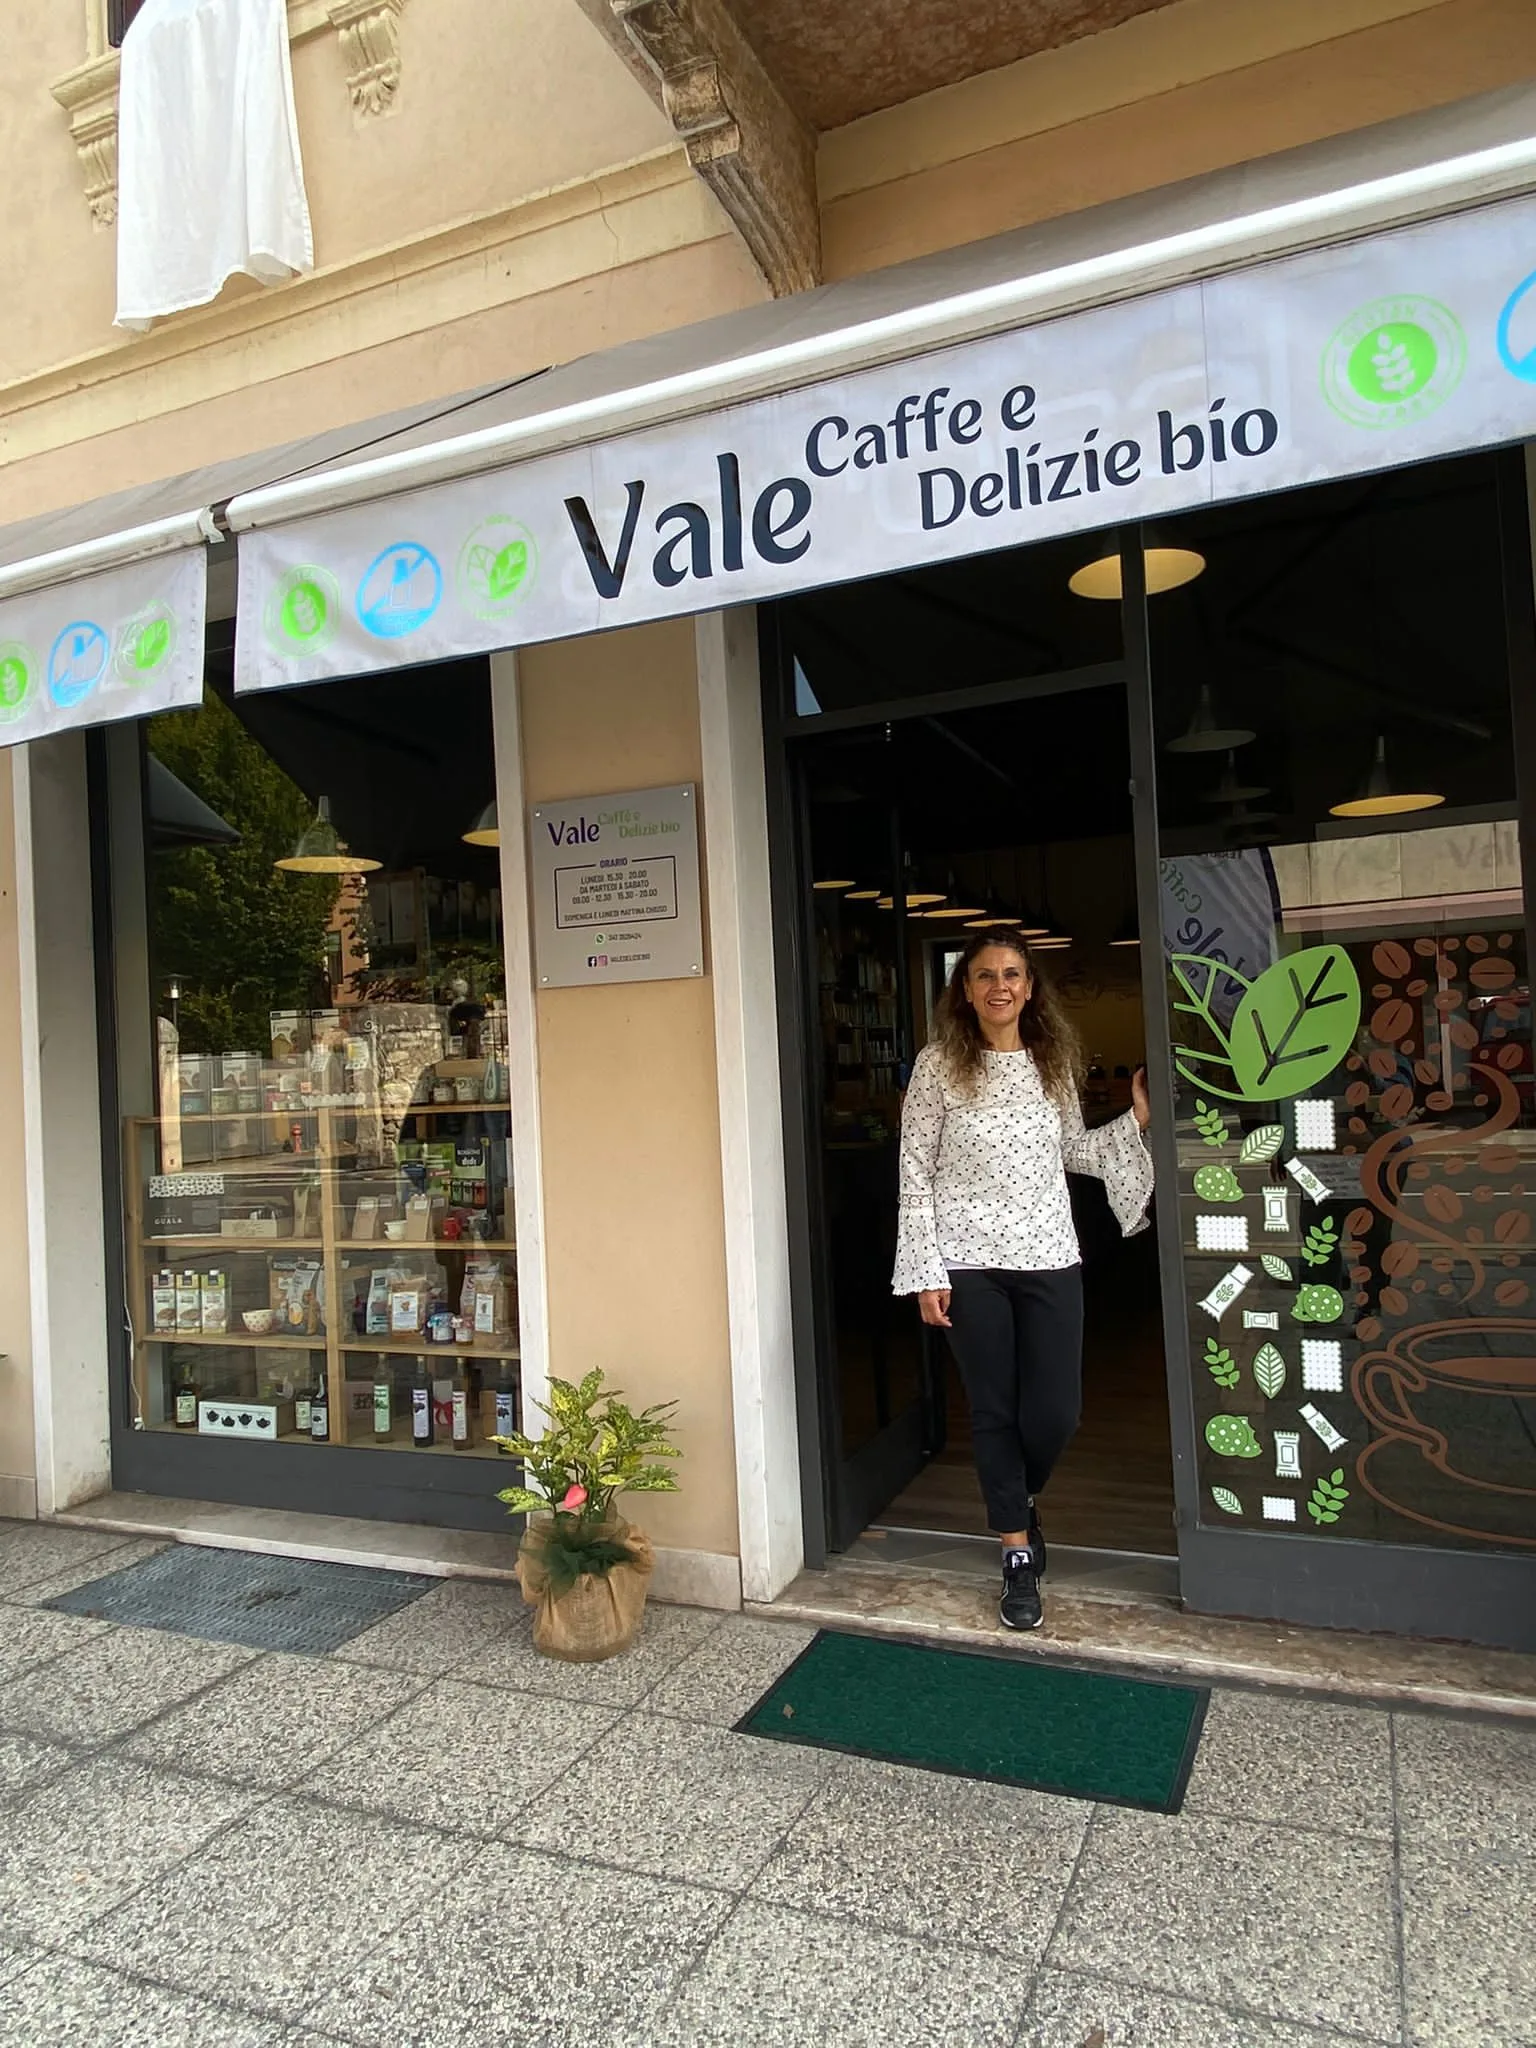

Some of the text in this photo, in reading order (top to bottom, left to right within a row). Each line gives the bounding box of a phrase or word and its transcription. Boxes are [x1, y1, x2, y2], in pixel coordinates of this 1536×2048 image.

[805, 384, 1036, 477] Caffe e
[917, 397, 1279, 531] Delizie bio
[564, 453, 813, 599] Vale
[547, 817, 600, 846] Vale
[619, 820, 680, 838] Delizie bio
[599, 857, 628, 868] ORARIO
[628, 870, 647, 879] 20.00
[579, 886, 588, 894] DA
[618, 881, 624, 890] A
[624, 880, 649, 890] SABATO
[639, 889, 658, 898] 20.00
[564, 912, 592, 922] DOMENICA
[620, 907, 645, 916] MATTINA
